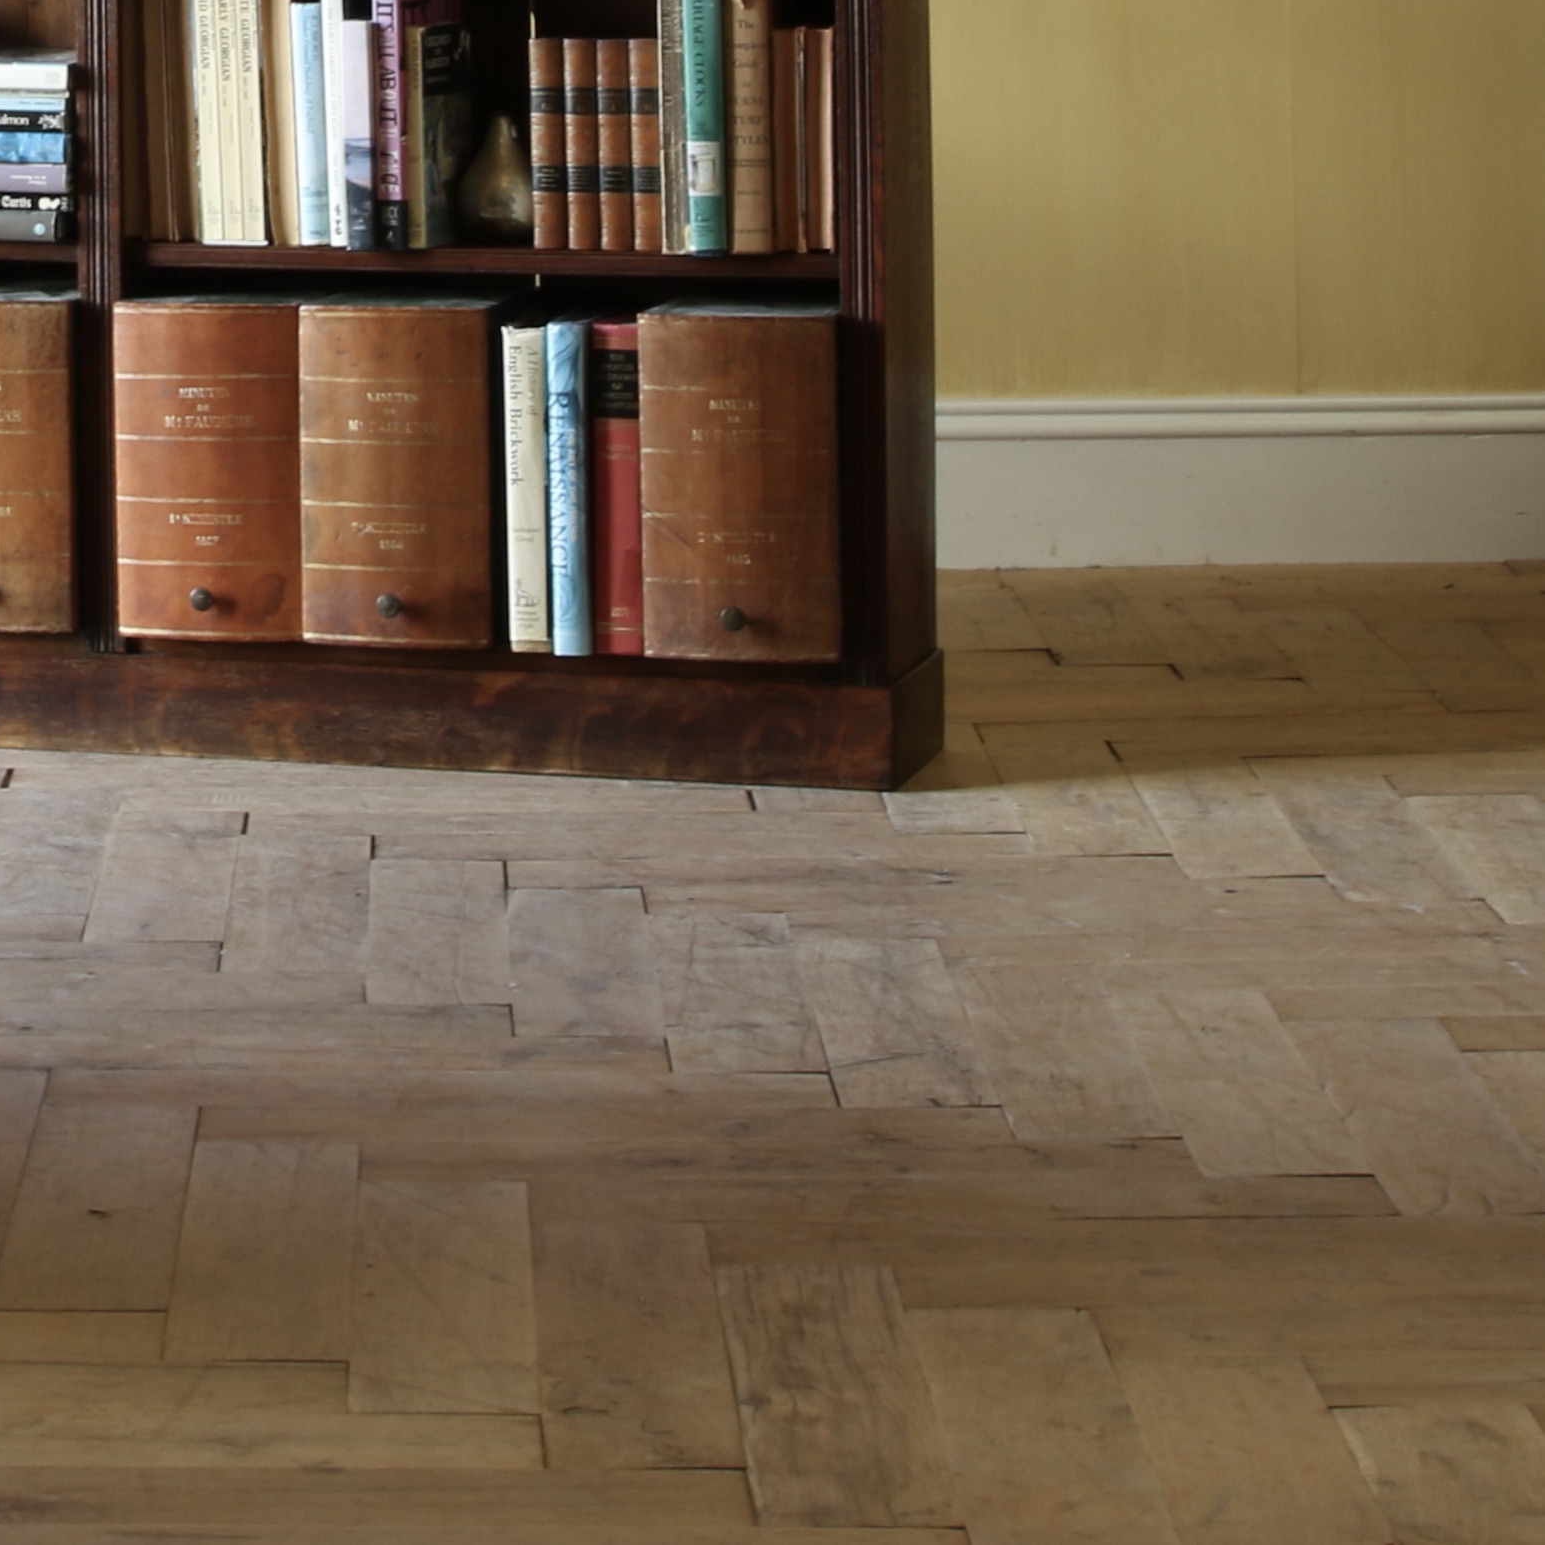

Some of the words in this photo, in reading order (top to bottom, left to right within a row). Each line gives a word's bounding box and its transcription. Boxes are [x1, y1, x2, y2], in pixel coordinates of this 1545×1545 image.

[200, 16, 211, 70] GEORGIAN
[220, 28, 231, 82] GEORGIAN
[241, 19, 252, 73] GEORGIAN
[379, 66, 398, 126] ABOUT
[693, 52, 706, 108] CLOCKS
[1, 195, 32, 209] Curtis
[507, 345, 523, 400] English
[527, 346, 539, 356] A
[527, 359, 540, 401] History
[528, 404, 539, 416] of
[509, 408, 524, 487] Brickwork
[550, 392, 571, 576] RENAISSANCE
